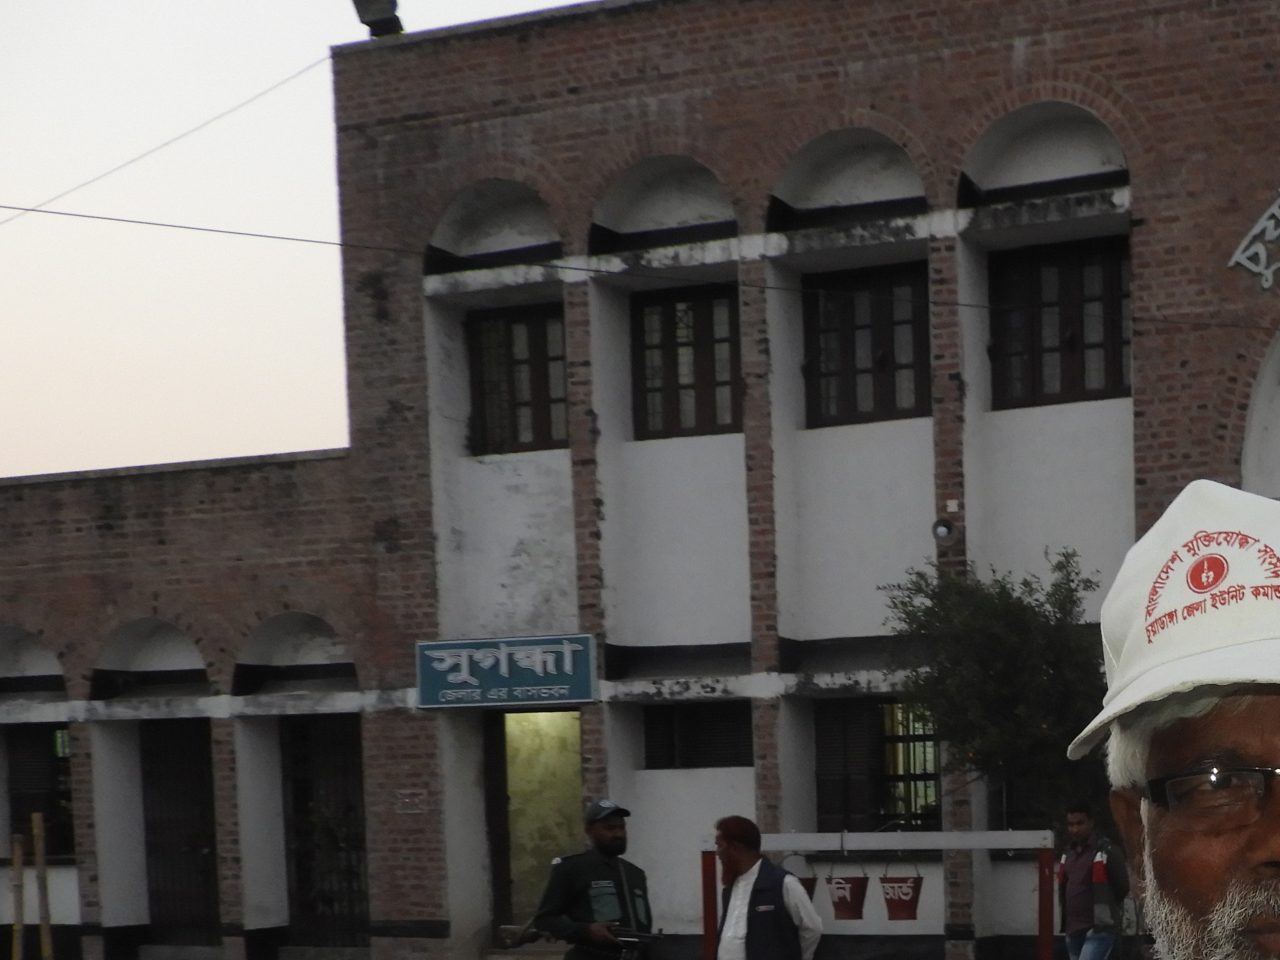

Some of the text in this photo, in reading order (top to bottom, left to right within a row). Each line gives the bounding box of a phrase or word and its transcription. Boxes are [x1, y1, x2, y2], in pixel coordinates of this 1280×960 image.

[1182, 530, 1259, 558] মুক্তিযোদ্ধা
[1181, 598, 1207, 621] জেলা
[1210, 584, 1246, 609] ইউনিট
[424, 640, 585, 686] সুগন্ধা
